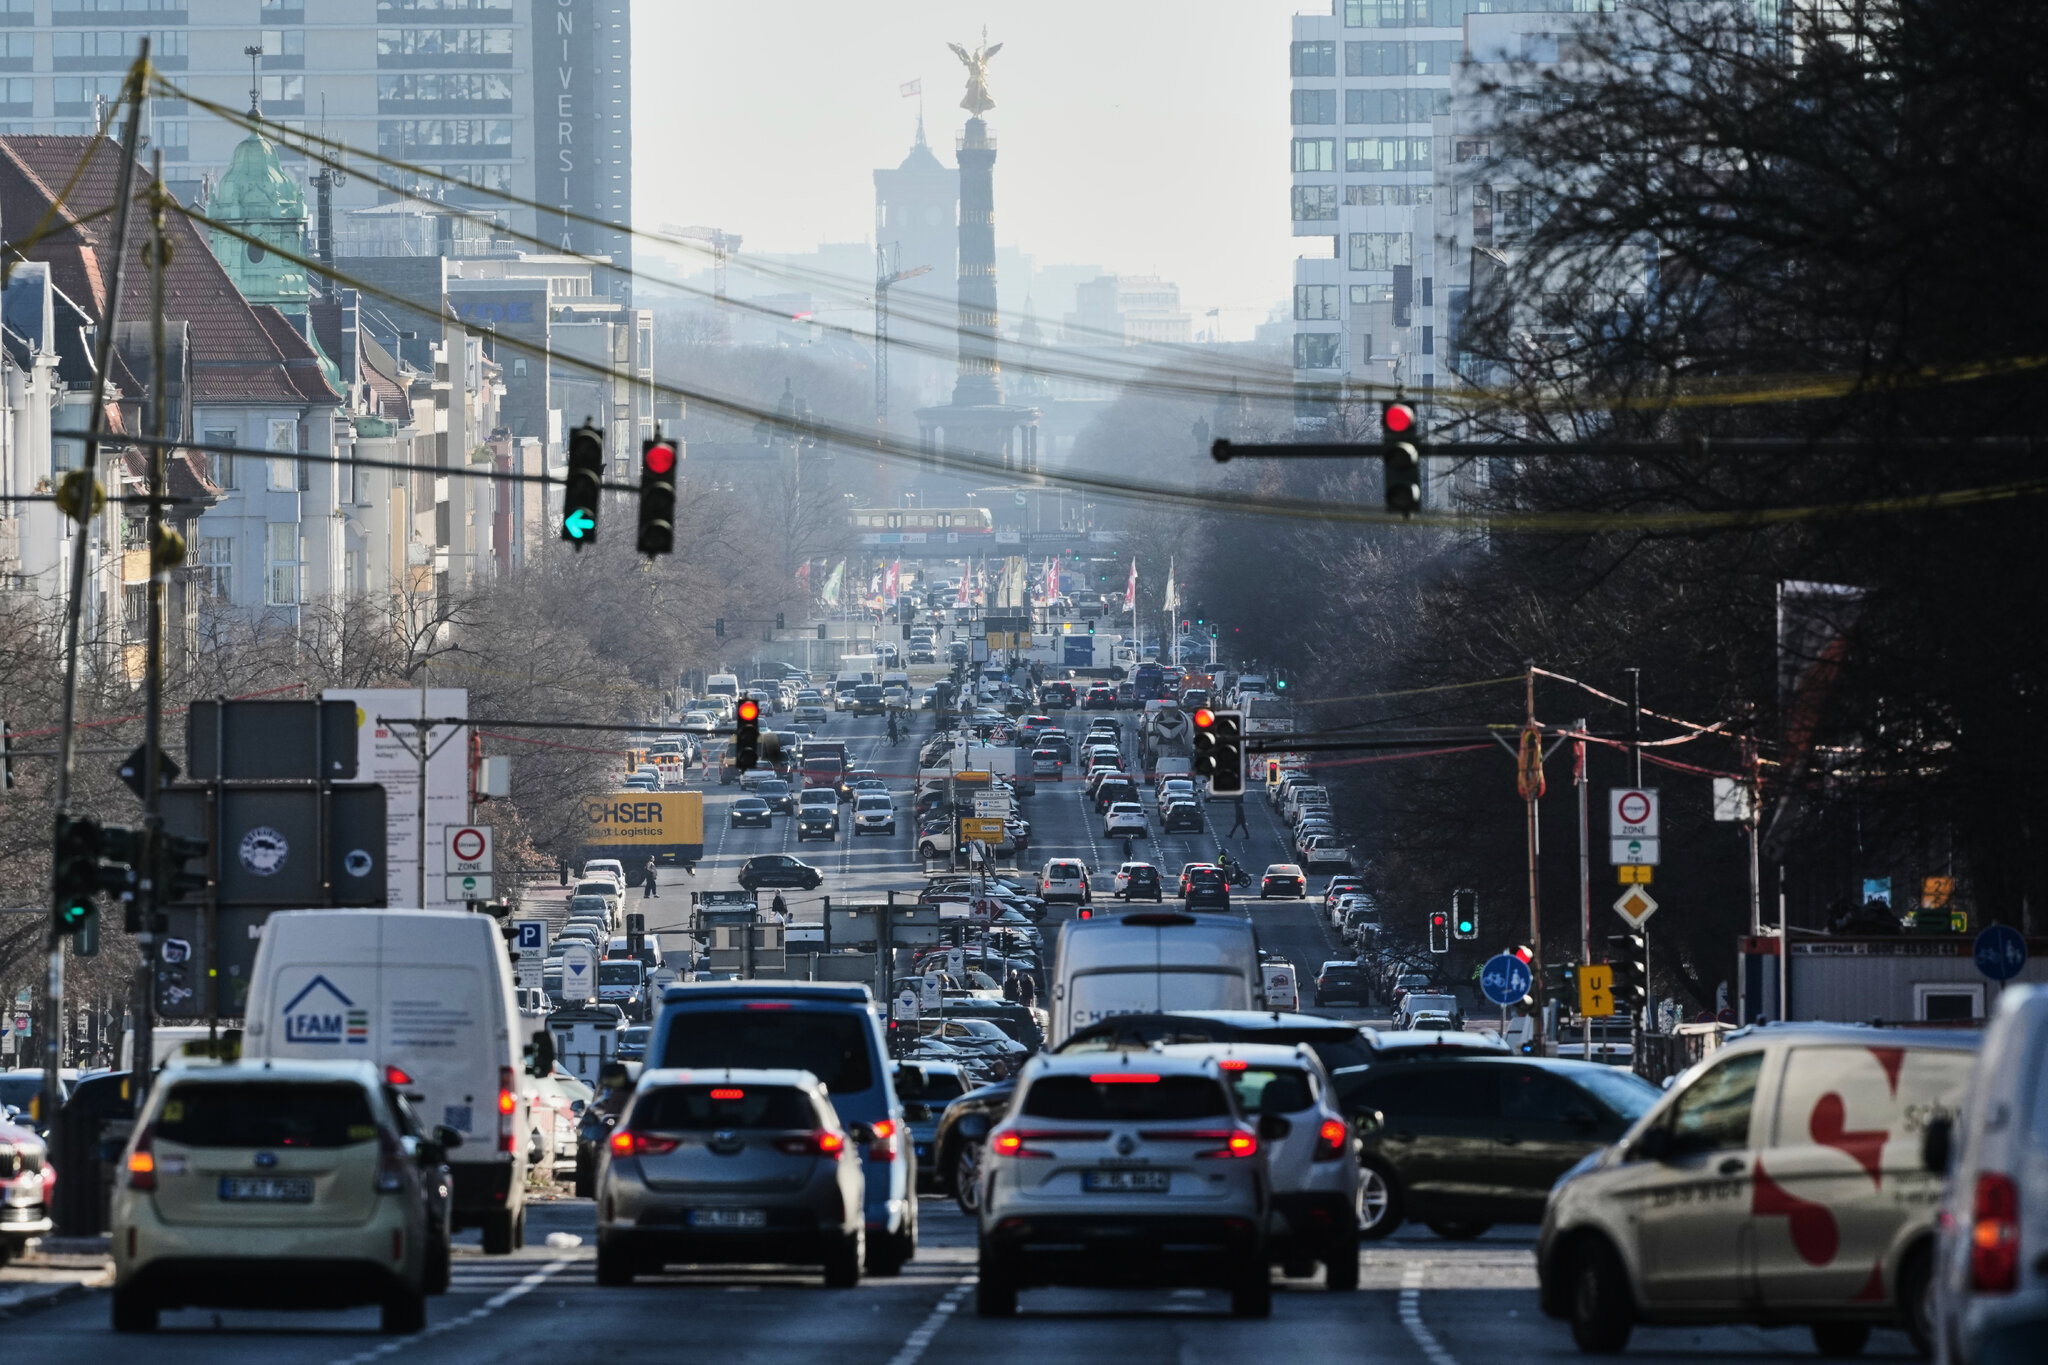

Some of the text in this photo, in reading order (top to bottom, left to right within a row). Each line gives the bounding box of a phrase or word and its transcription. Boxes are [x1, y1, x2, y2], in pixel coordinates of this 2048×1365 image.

[557, 0, 574, 254] NIVERSITÄ
[614, 827, 663, 837] Logistics
[1622, 826, 1646, 834] ZONE
[457, 862, 482, 871] ZONE
[524, 927, 536, 944] P
[521, 949, 540, 958] ZONE
[1590, 977, 1602, 990] U
